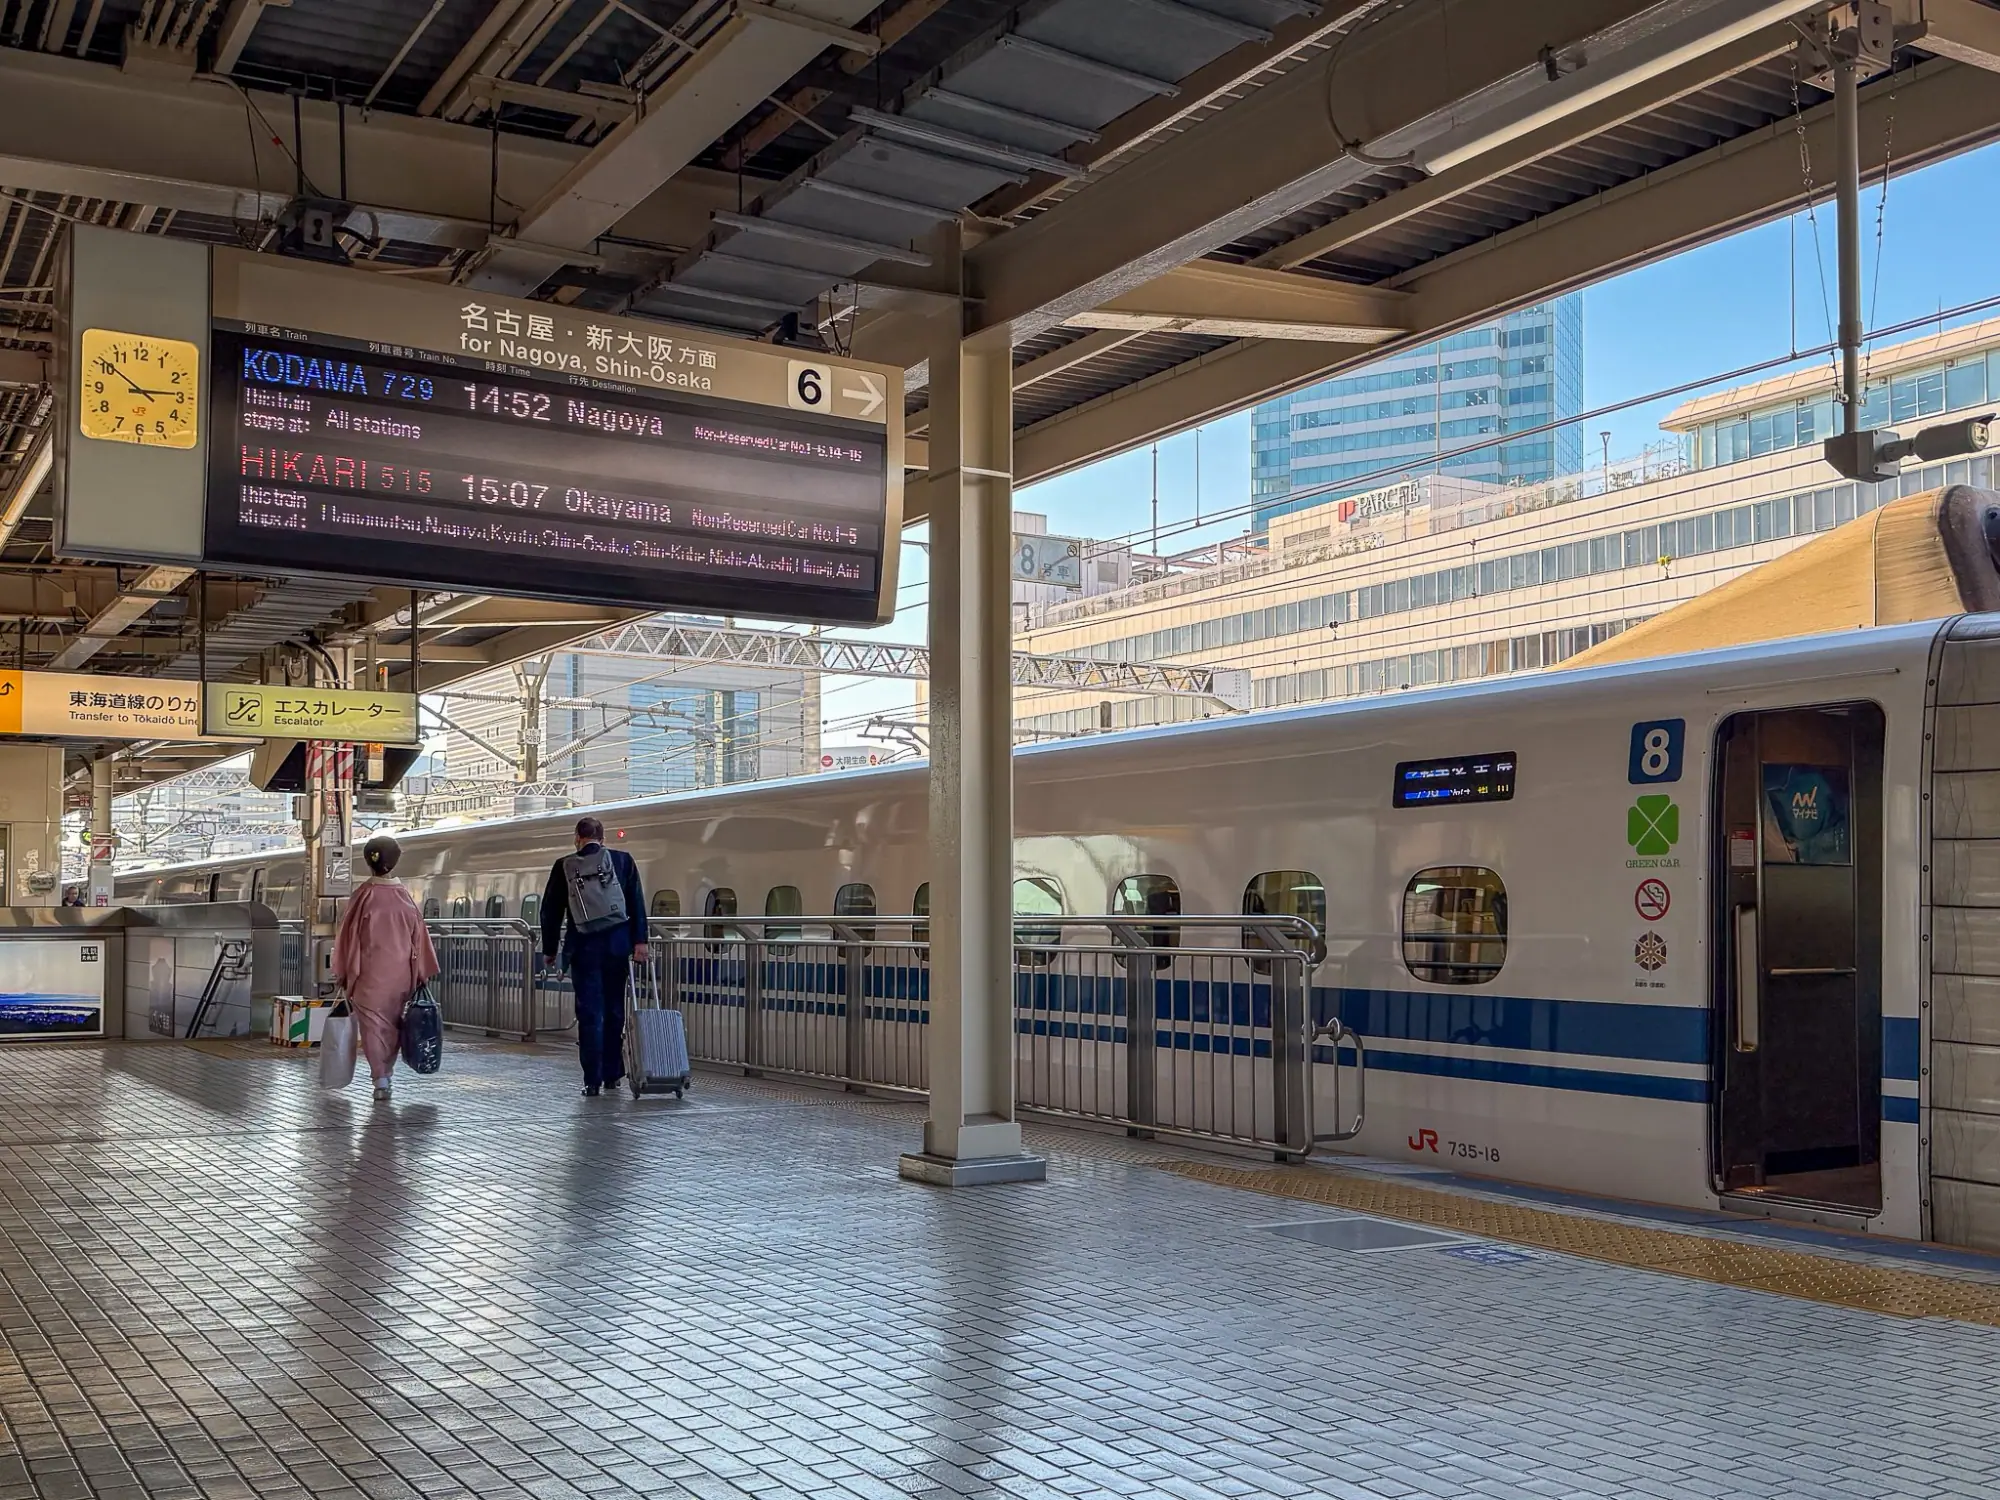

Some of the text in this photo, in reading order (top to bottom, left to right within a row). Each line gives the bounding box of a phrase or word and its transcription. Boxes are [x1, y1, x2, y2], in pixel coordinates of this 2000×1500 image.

[245, 322, 308, 341] 列車名 Train
[113, 351, 127, 364] 11
[133, 347, 149, 361] 12
[369, 341, 457, 365] 列車番号 Train No.
[157, 356, 164, 369] 1
[459, 332, 712, 391] for Nagoya, Shin-Ōsaka
[485, 361, 531, 377] 時刻 Time
[171, 372, 180, 384] 2
[568, 375, 637, 394] 行先 Destination
[94, 381, 104, 394] 9
[243, 347, 368, 396] KODAMA
[383, 371, 434, 401] 729
[463, 382, 551, 421] 14:52
[567, 400, 663, 436] Nagoya
[797, 368, 822, 405] 6
[175, 391, 185, 404] 3
[100, 400, 109, 413] 8
[132, 406, 147, 416] JR
[169, 409, 179, 421] 4
[115, 416, 124, 429] 7
[135, 423, 144, 436] 6
[155, 420, 165, 433] 5
[326, 409, 349, 430] All
[353, 416, 421, 439] stations
[241, 444, 367, 489] HIKARI
[380, 465, 432, 494] 515
[462, 474, 549, 509] 15:07
[565, 487, 672, 524] Okayama
[1020, 544, 1034, 575] 8
[274, 700, 401, 718] エスカレーター
[69, 711, 114, 722] Transfer
[118, 713, 129, 722] to
[133, 713, 175, 725] Tōkaidō
[274, 715, 324, 727] Escalator
[1640, 728, 1670, 777] 8
[1792, 808, 1819, 820] マイナビ
[1625, 858, 1681, 869] GREEN CAR
[1407, 1128, 1501, 1163] JR 735-18
